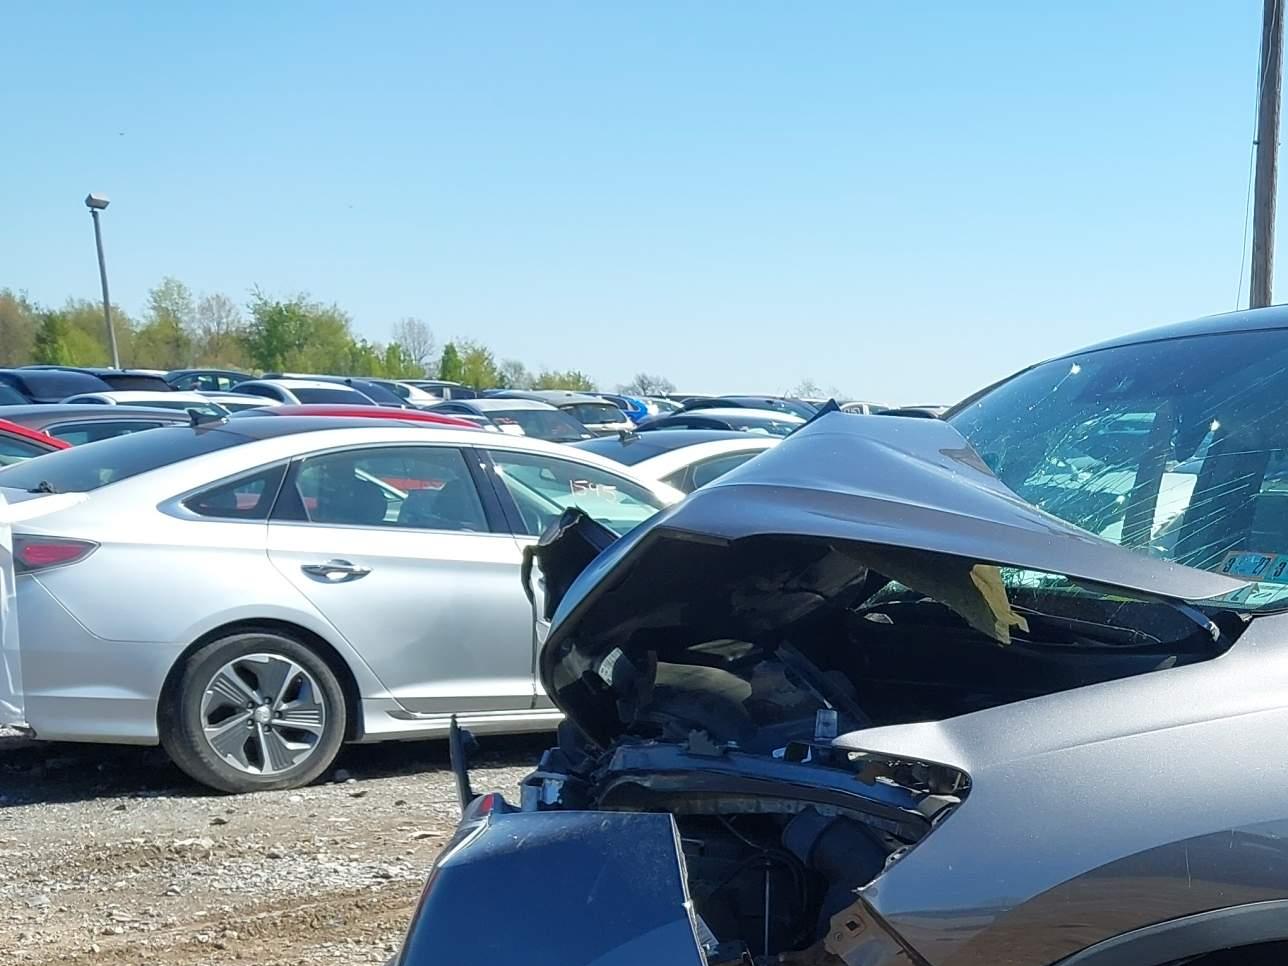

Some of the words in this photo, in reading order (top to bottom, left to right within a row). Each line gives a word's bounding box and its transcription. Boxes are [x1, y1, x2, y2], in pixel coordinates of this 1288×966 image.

[1222, 557, 1236, 573] 3
[1252, 556, 1272, 577] 27
[1273, 560, 1287, 577] 3
